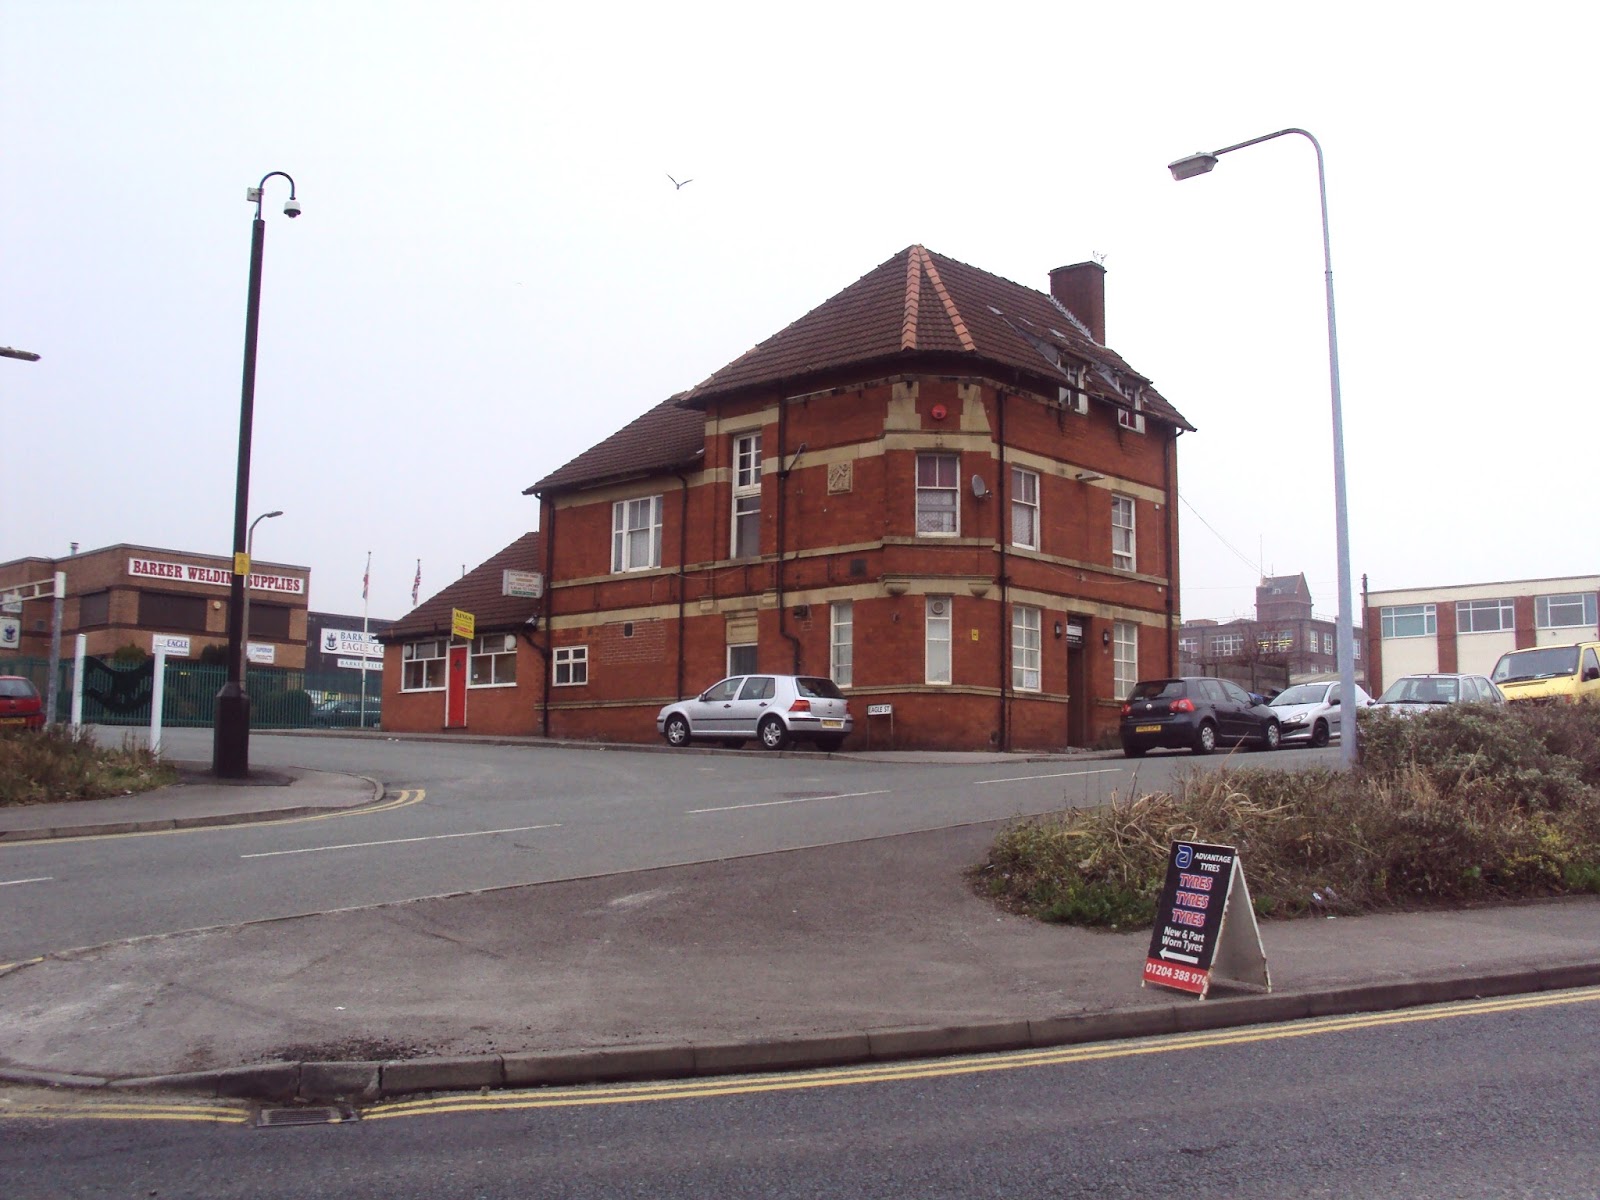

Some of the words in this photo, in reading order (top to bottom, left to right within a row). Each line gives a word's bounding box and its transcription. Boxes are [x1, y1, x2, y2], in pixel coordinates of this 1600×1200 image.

[133, 560, 183, 579] BARKER
[187, 566, 233, 585] WELDIN
[167, 638, 188, 648] EAGLE
[340, 632, 373, 642] BARKR
[1194, 852, 1232, 863] ADVANTAGE
[1200, 862, 1220, 872] TYRES
[1180, 873, 1214, 891] TYRES
[1176, 890, 1210, 909] TYRES
[1171, 908, 1206, 927] TYRES
[1163, 926, 1182, 937] New
[1181, 930, 1188, 939] &
[1188, 931, 1205, 942] Part
[1161, 936, 1182, 948] Worn
[1183, 940, 1203, 952] Tyres
[1145, 963, 1173, 978] 01204
[1173, 969, 1190, 982] 388
